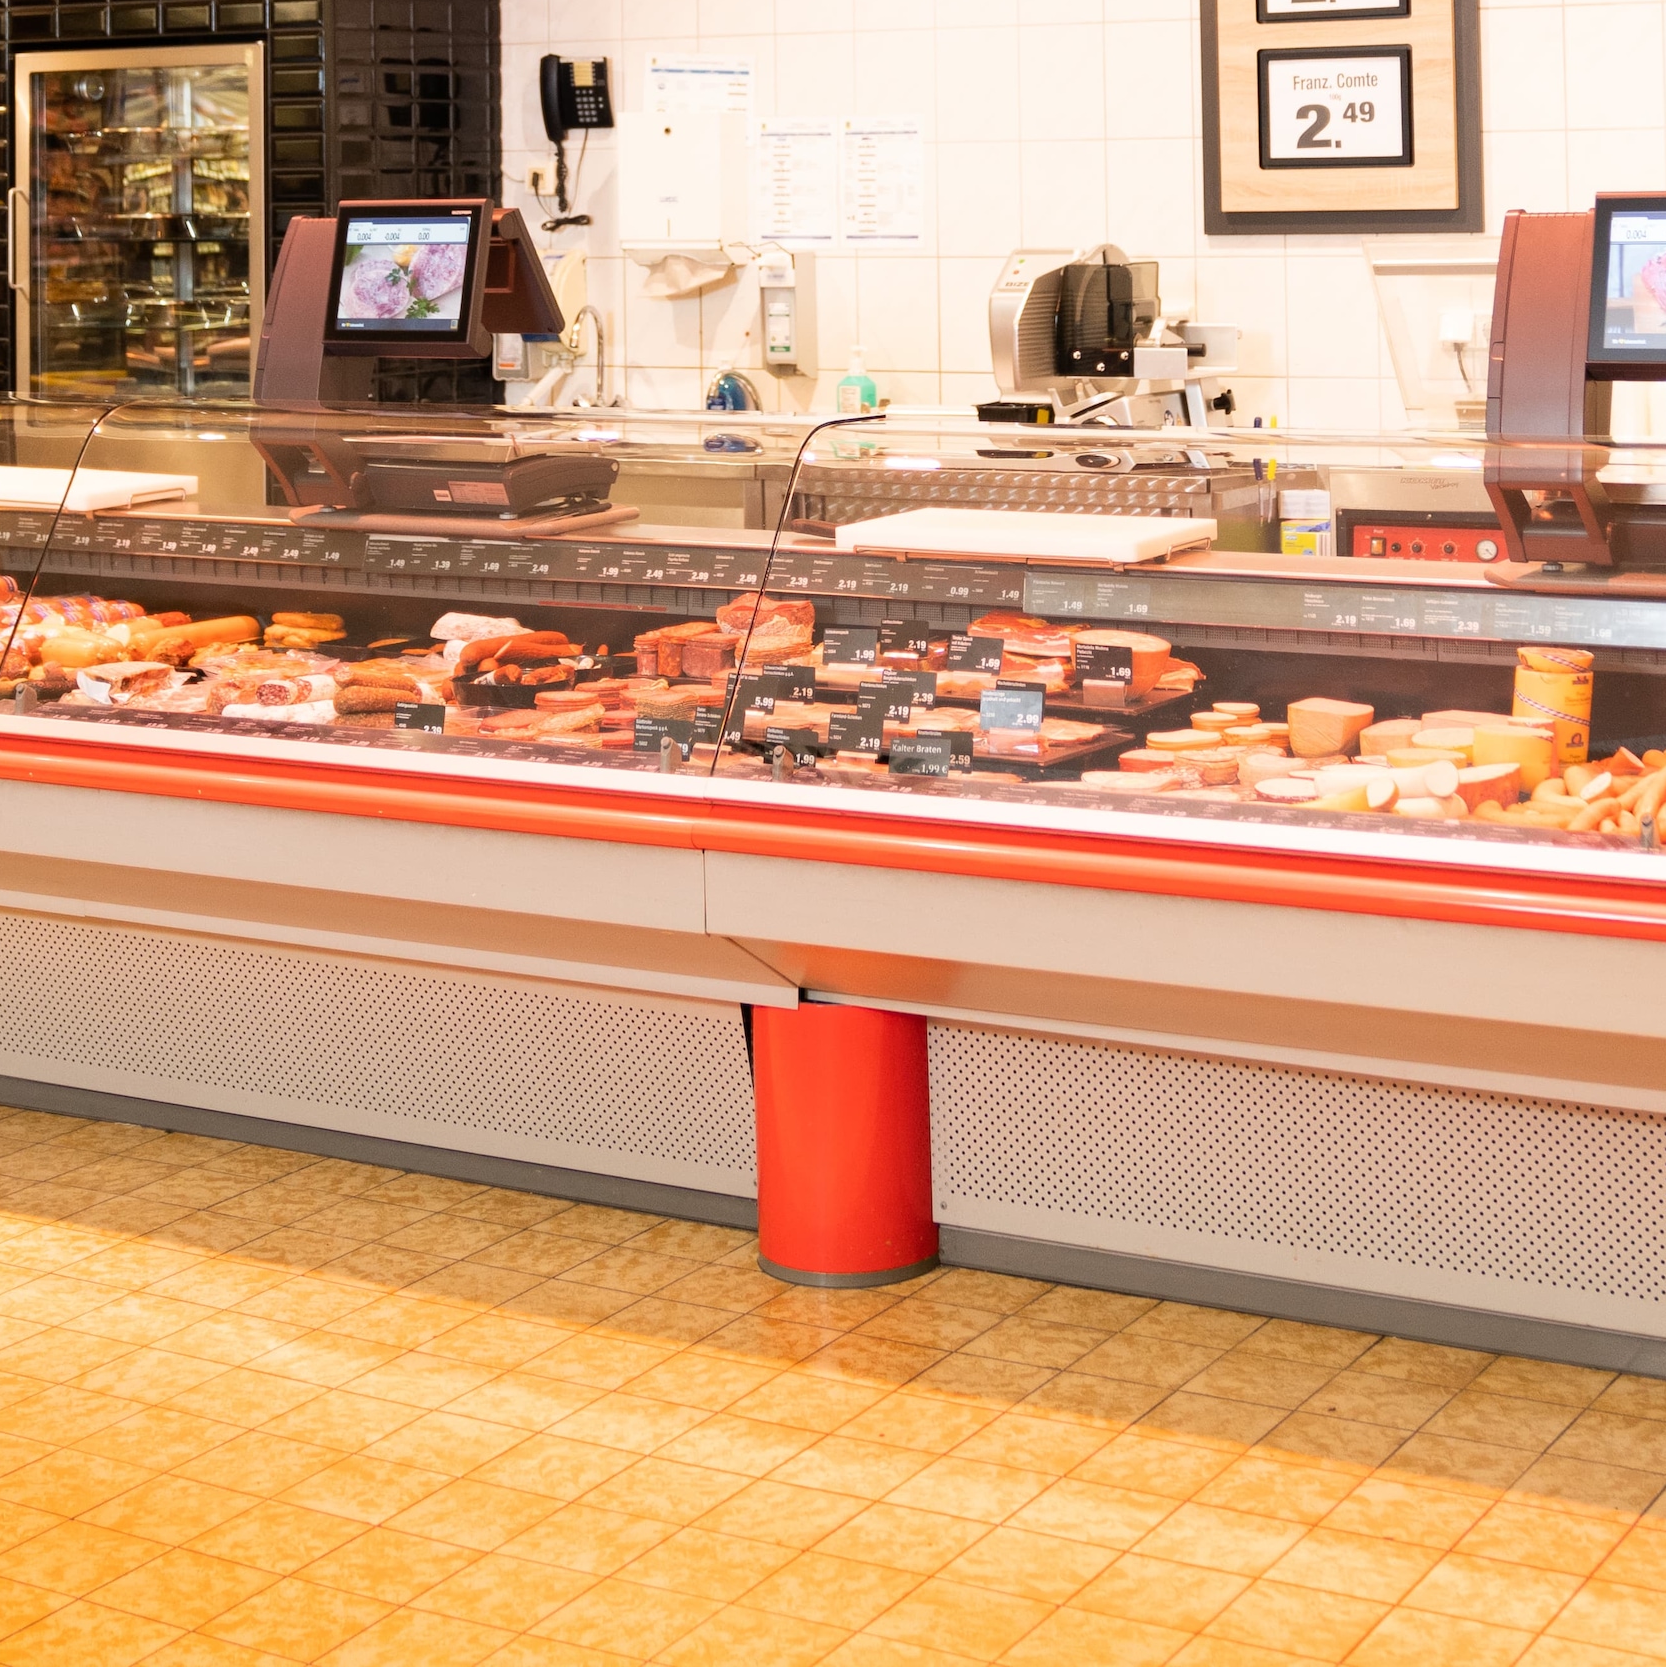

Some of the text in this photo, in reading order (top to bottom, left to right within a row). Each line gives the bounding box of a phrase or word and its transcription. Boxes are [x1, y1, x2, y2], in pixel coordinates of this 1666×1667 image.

[1293, 72, 1378, 90] Franz. Comte
[646, 569, 663, 578] 2.49
[790, 576, 808, 586] 2.39
[839, 580, 857, 588] 2.19
[890, 582, 909, 592] 2.19
[950, 586, 969, 596] 0.99
[1001, 590, 1019, 599] 1.49
[1063, 600, 1083, 610] 1.49
[1129, 604, 1148, 614] 1.69
[1335, 614, 1357, 625] 2.19
[1395, 618, 1415, 628] 1.69
[1457, 620, 1479, 631] 2.39
[908, 640, 927, 648] 2.19
[855, 650, 875, 659] 1.99
[981, 657, 1001, 668] 1.69
[1111, 666, 1131, 678] 1.69
[793, 686, 813, 697] 2.19
[755, 696, 774, 706] 5.99
[913, 692, 933, 702] 2.39
[889, 705, 909, 715] 2.19
[1017, 713, 1039, 724] 2.99
[423, 725, 443, 734] 239
[860, 737, 880, 748] 2.19
[892, 743, 942, 754] Kalter Braten
[795, 754, 815, 764] 1.99
[949, 754, 971, 765] 2.59
[941, 765, 948, 774] €
